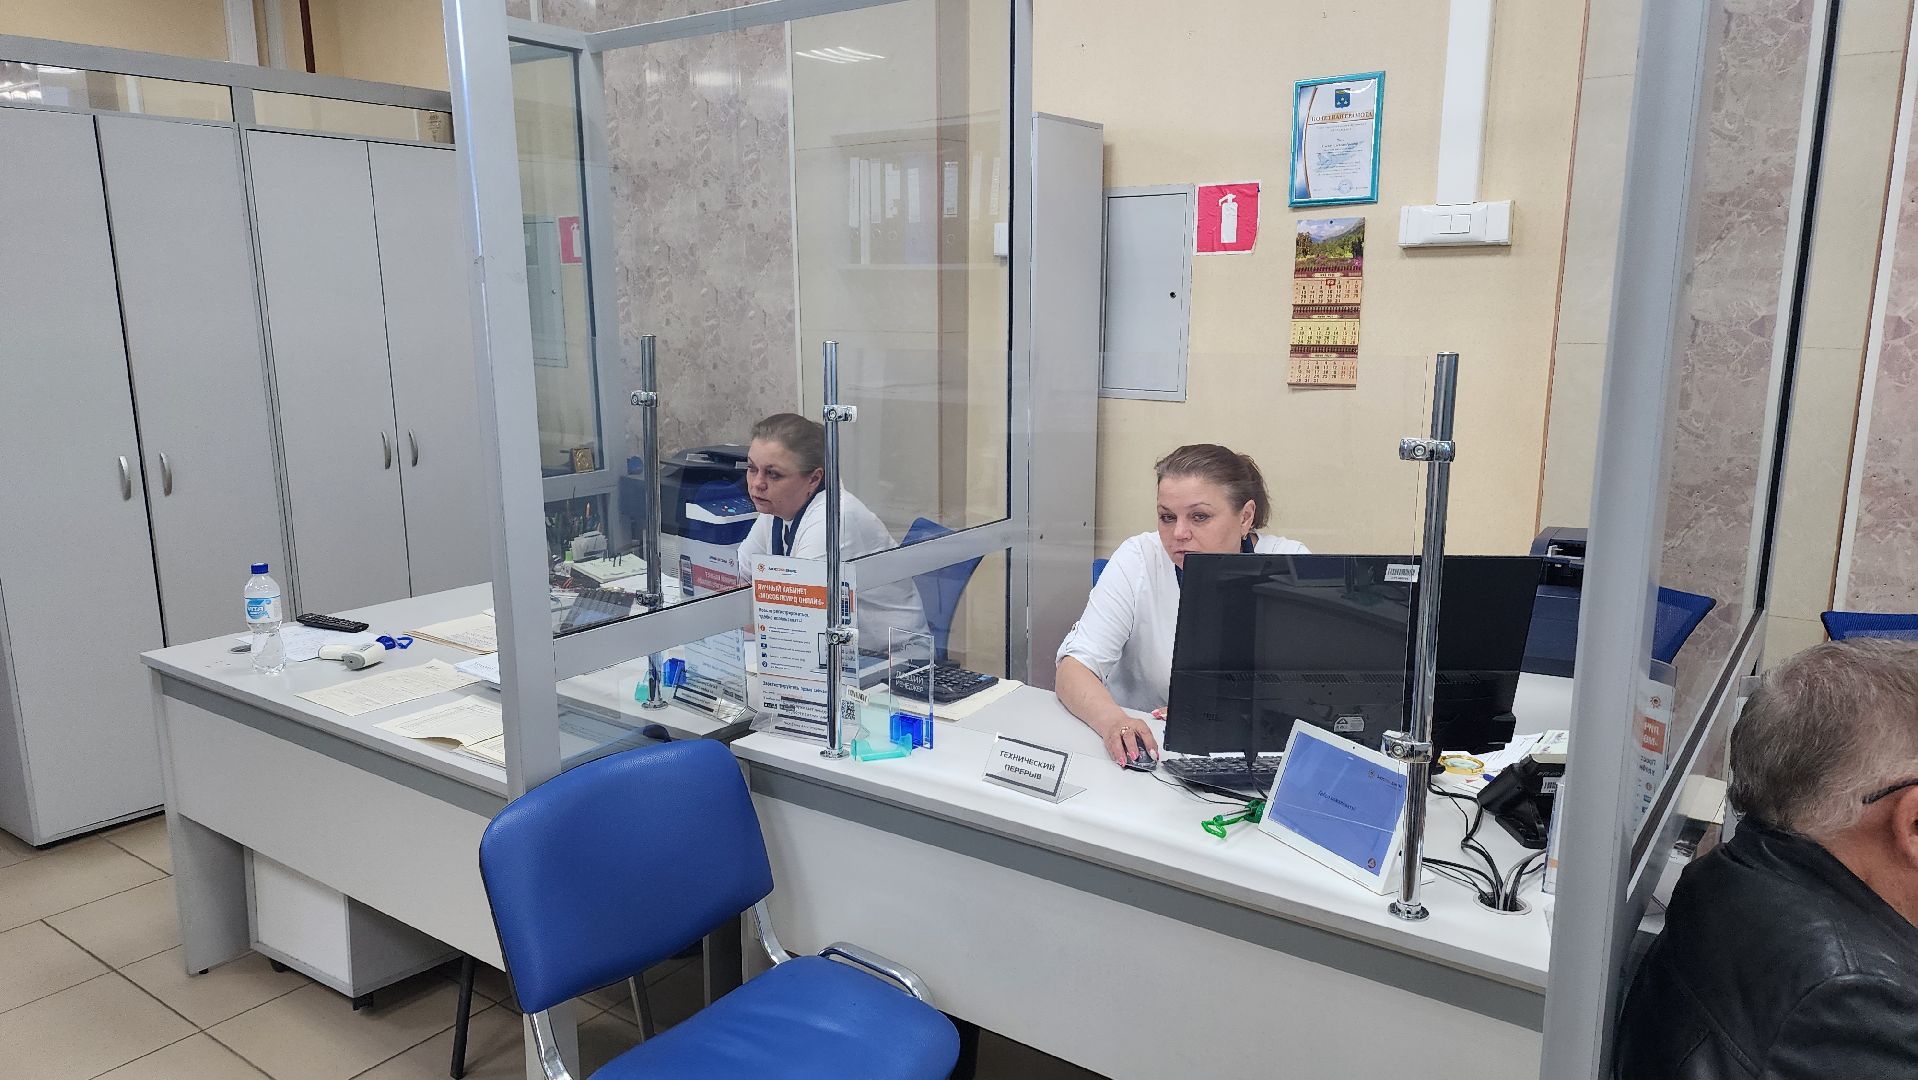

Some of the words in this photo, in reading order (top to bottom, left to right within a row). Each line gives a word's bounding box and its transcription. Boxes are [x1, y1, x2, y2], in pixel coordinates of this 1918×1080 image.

[757, 583, 781, 593] ЛИЧНЫЙ
[782, 586, 807, 595] КАБИНЕТ
[1000, 750, 1055, 772] ТЕХНИЧЕСКИЙ
[1004, 763, 1042, 780] ПЕРЕРЫВ
